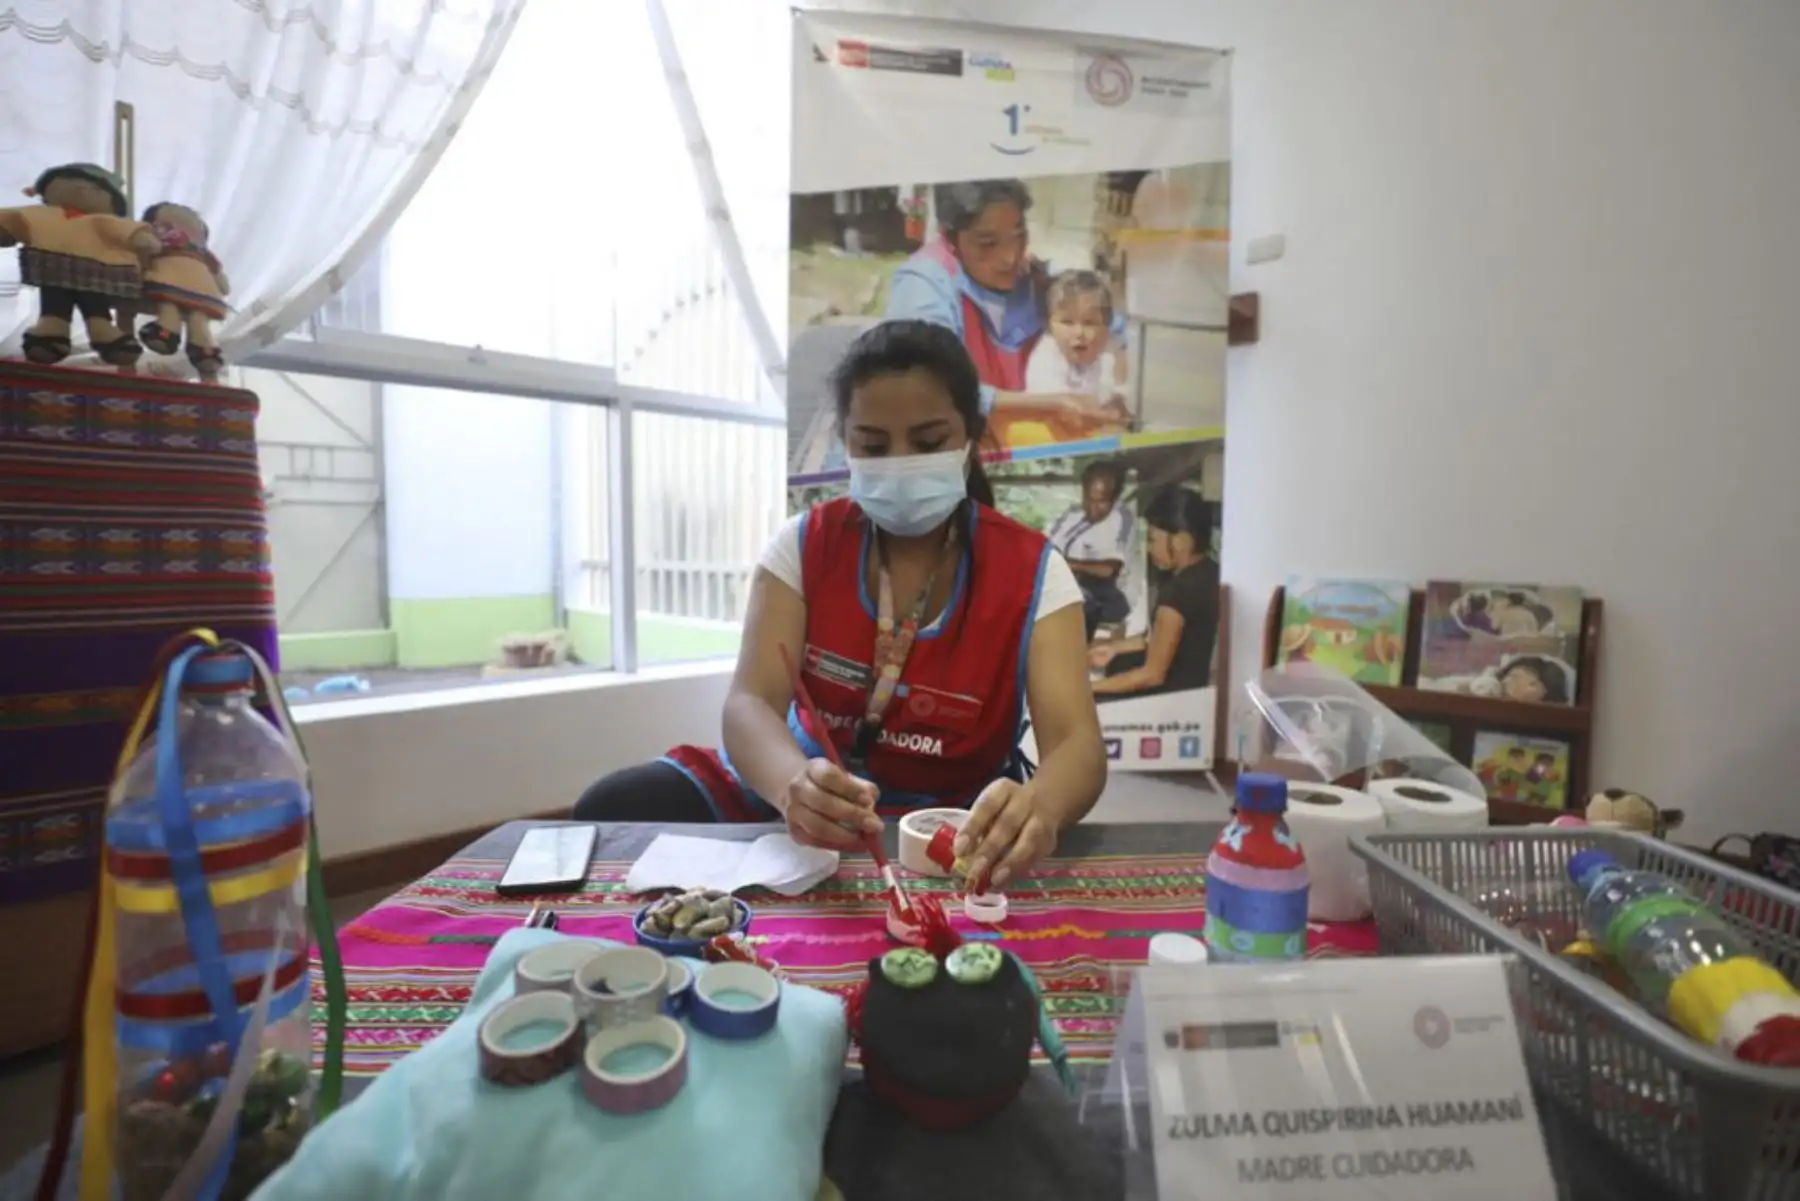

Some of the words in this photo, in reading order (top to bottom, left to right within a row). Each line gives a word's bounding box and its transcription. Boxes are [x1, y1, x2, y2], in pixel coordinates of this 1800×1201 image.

[1168, 1112, 1257, 1139] ZULMA
[1262, 1104, 1404, 1138] QUISPIRINA
[1237, 1153, 1327, 1183] MADRE
[1332, 1147, 1474, 1179] CUIDADORA
